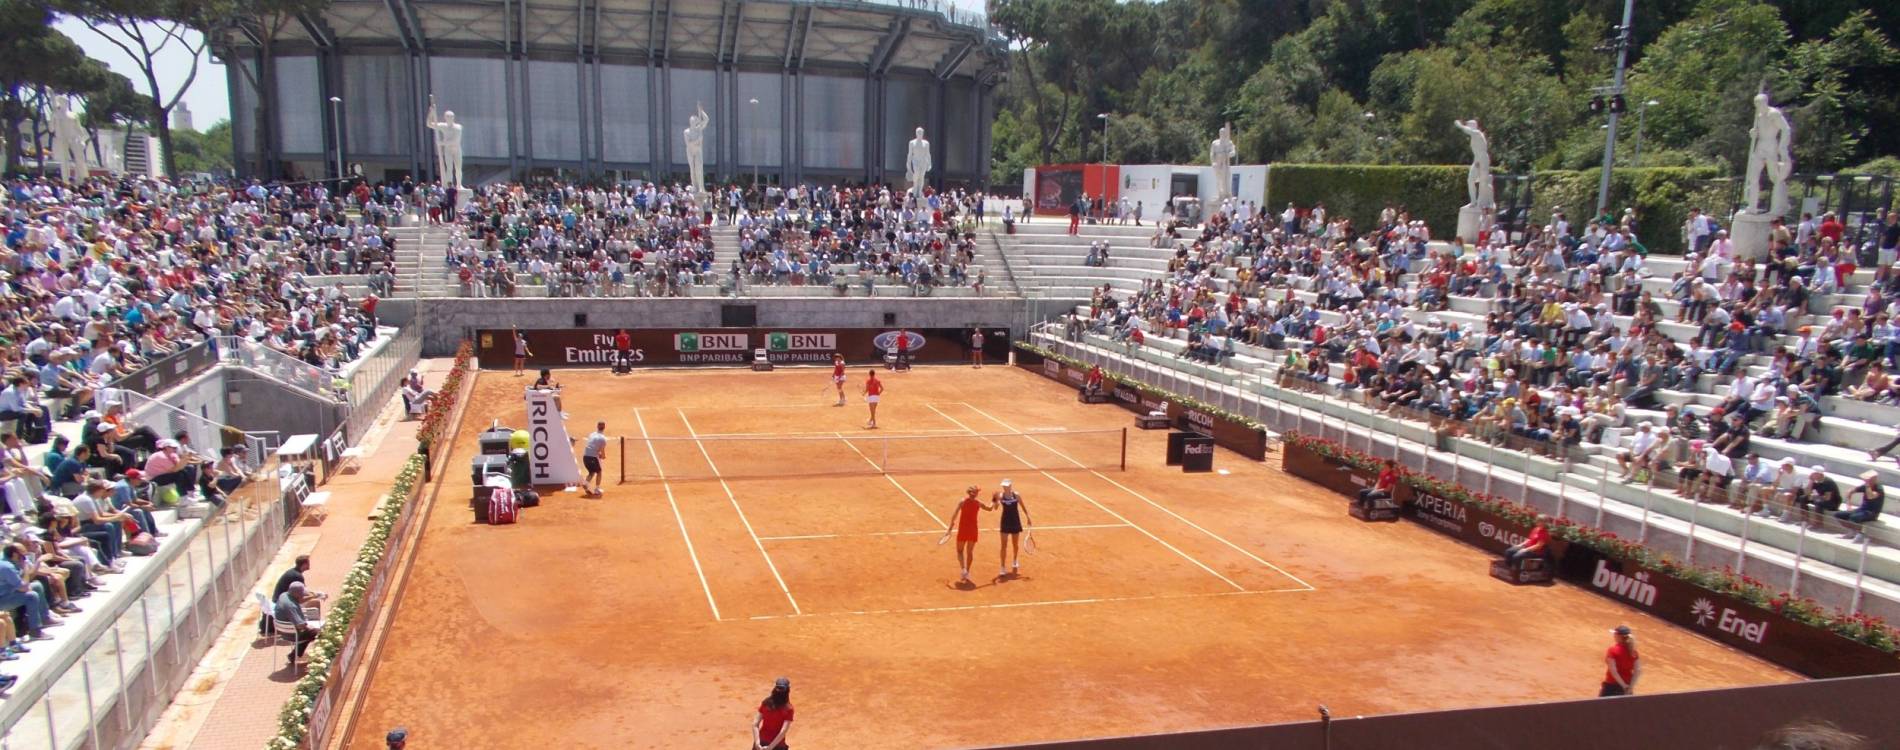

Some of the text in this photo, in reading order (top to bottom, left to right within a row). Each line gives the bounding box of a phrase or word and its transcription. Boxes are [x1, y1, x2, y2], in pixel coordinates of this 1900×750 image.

[594, 334, 615, 347] Fly
[702, 335, 743, 348] BNL
[791, 335, 831, 348] BNL
[565, 347, 644, 363] Emiraes
[679, 353, 743, 362] BNP PARIBAS
[769, 353, 832, 361] BNP PARIBAS
[1188, 410, 1214, 428] RICOH
[532, 400, 550, 479] RICOH
[1415, 490, 1467, 523] XPERIA
[1592, 559, 1657, 607] bwin
[1718, 607, 1768, 643] Enel
